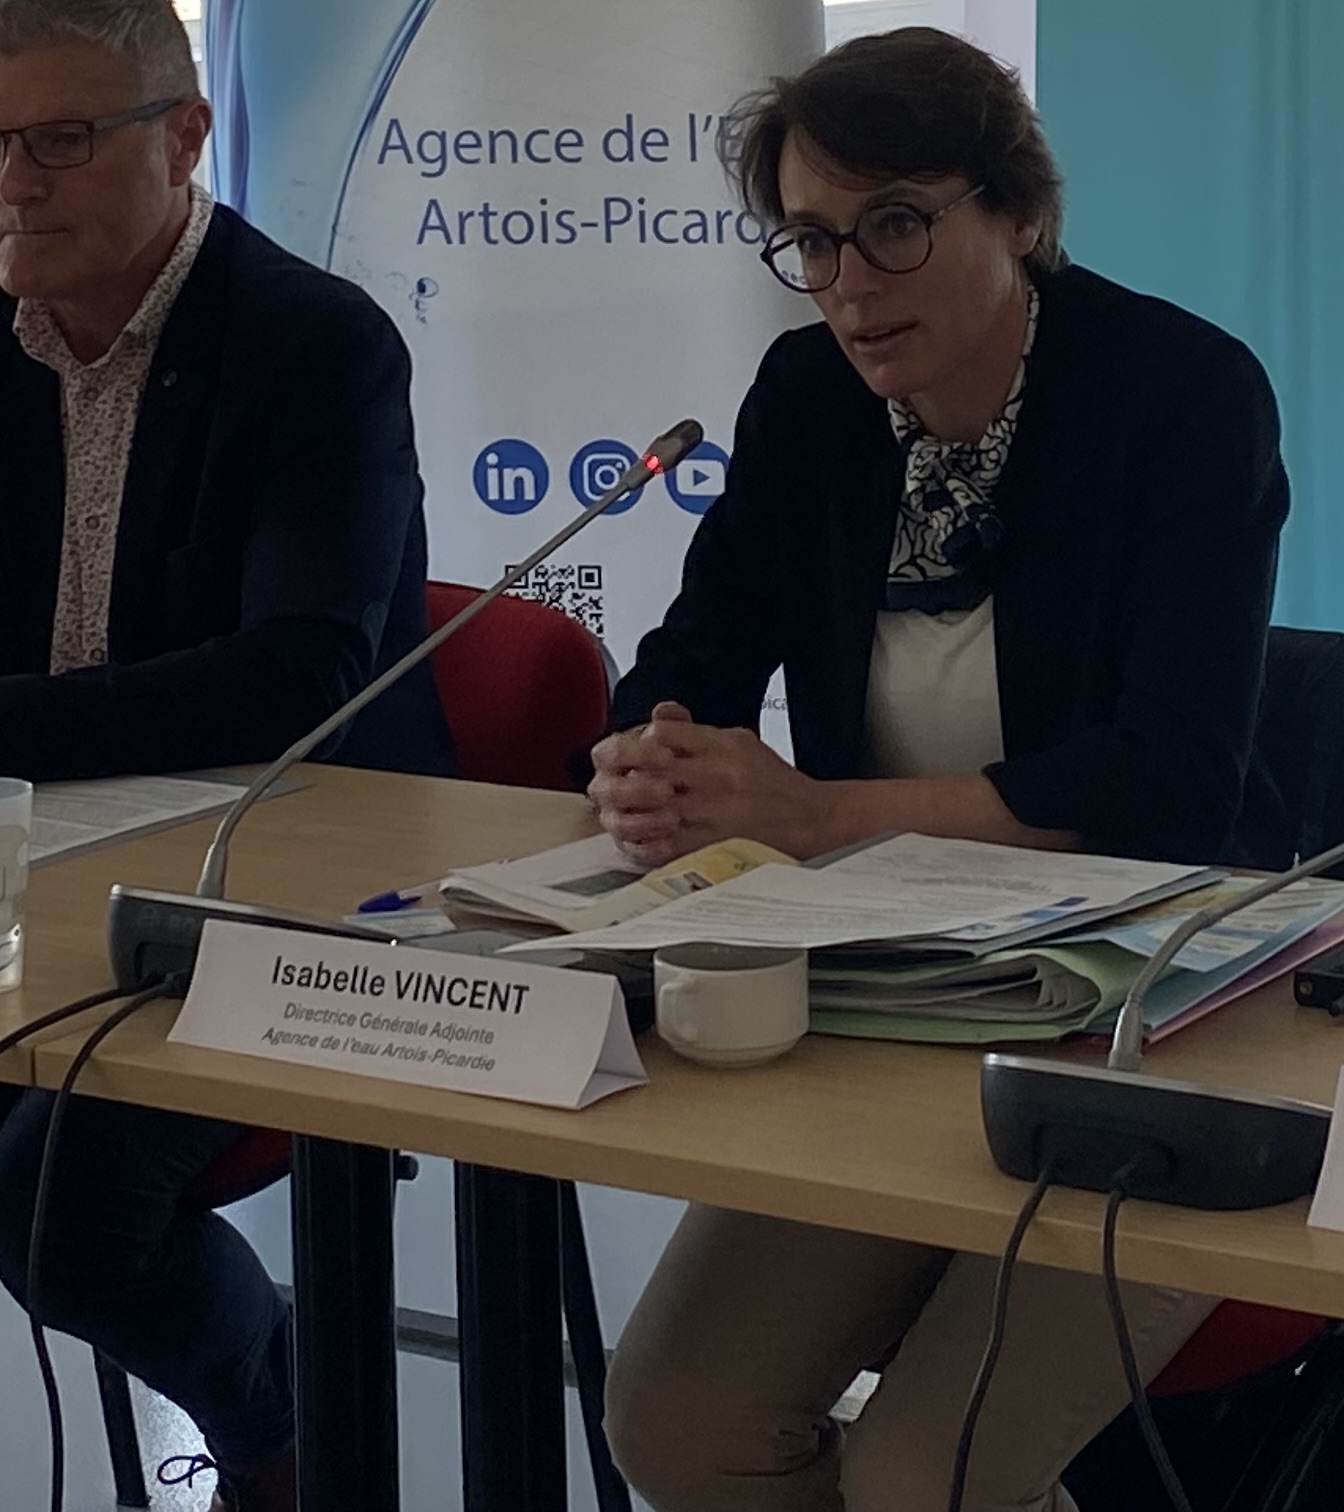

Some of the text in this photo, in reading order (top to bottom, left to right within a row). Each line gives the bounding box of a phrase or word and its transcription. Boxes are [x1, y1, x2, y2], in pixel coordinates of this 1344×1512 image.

[378, 112, 744, 178] Agence de l'E
[416, 196, 768, 245] Artois-Picard
[272, 955, 530, 1015] Isabelle VINCENT
[283, 1001, 495, 1045] Directrice Générale Adjointe
[261, 1026, 496, 1072] Agence de l'eau Artois-Picardie
